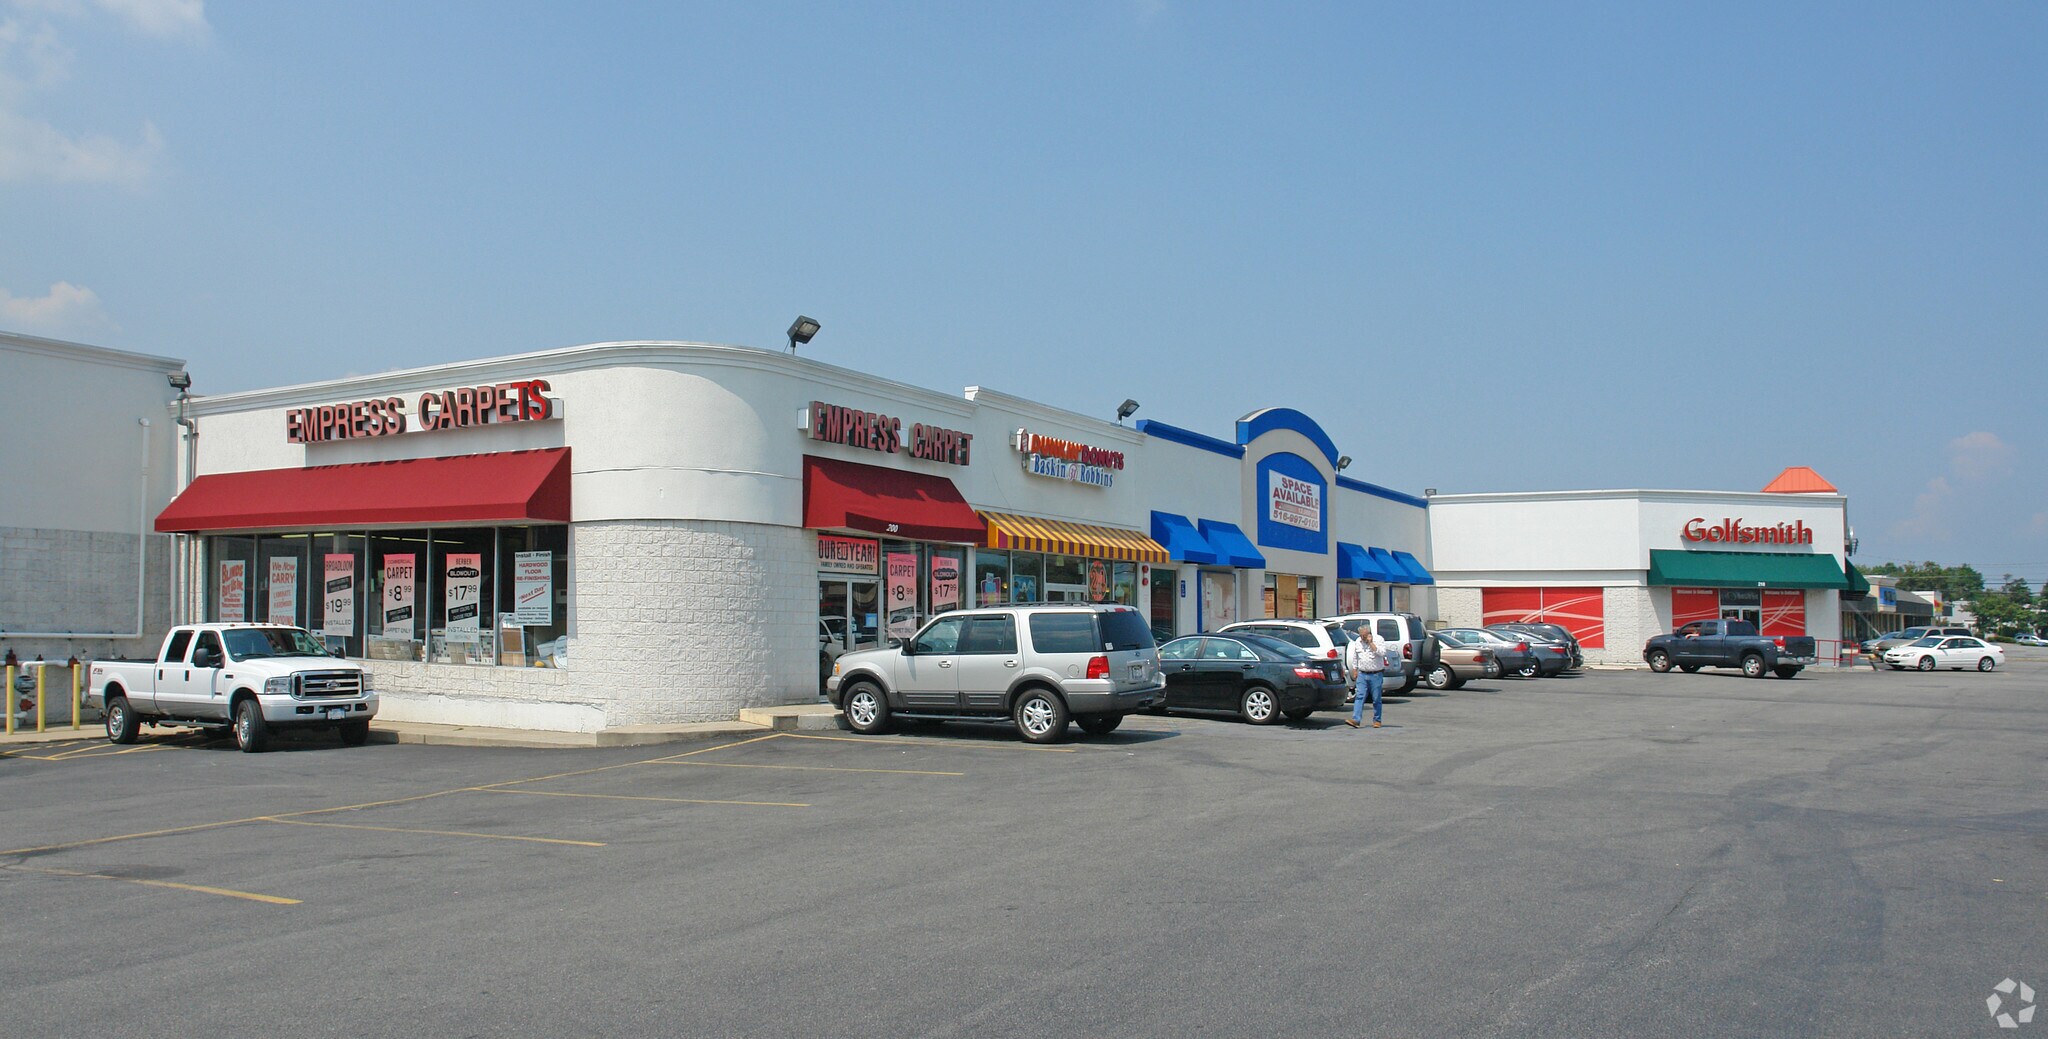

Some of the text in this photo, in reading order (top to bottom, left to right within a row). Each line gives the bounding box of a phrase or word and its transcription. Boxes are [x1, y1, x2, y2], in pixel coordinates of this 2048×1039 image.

[287, 380, 554, 443] EMPRESS CARPETS
[811, 400, 974, 466] EMPRESS CARPET
[1081, 445, 1125, 470] DONUTS
[1034, 455, 1066, 479] Baskin
[1080, 464, 1113, 488] Robbins
[1281, 477, 1313, 496] SPACE
[1273, 487, 1319, 510] AVAILABLE
[886, 523, 899, 533] 200
[1684, 517, 1813, 545] Golfsmith
[818, 539, 836, 560] OUR
[849, 542, 876, 563] YEAR!
[272, 572, 296, 584] CARRY
[386, 566, 413, 579] CARPET
[890, 564, 915, 577] CARPET
